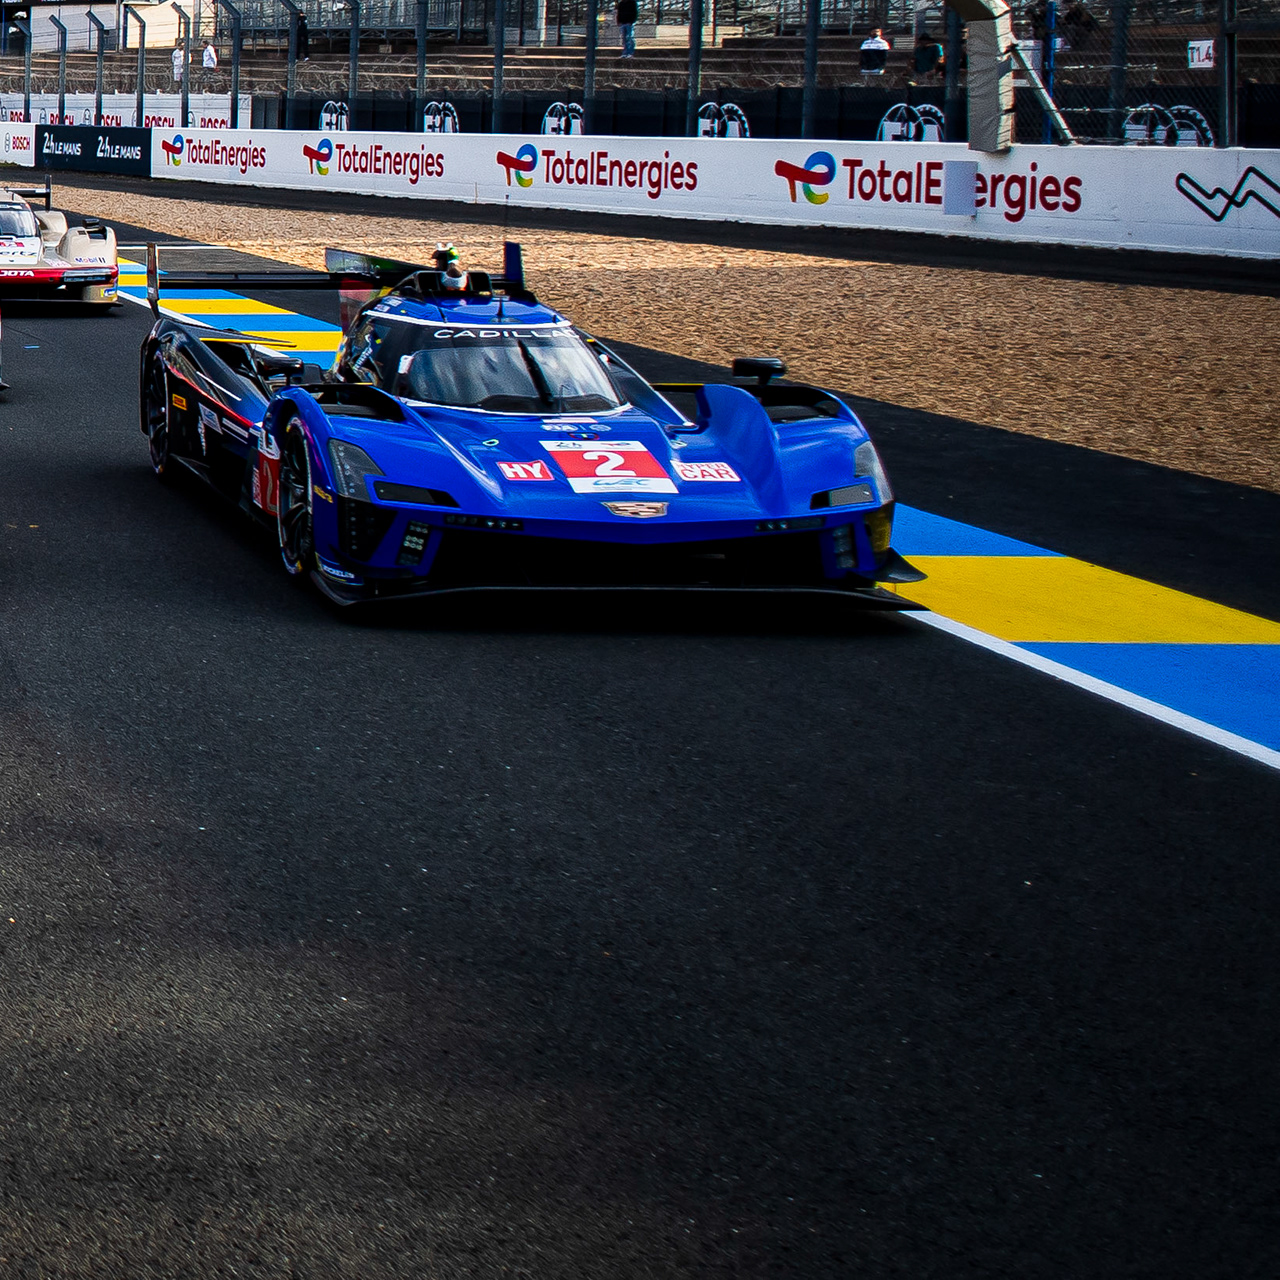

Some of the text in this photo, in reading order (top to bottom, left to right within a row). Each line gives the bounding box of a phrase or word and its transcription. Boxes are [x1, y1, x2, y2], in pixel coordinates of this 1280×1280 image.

[12, 136, 30, 150] BOSCH
[55, 142, 63, 154] LE
[63, 143, 82, 156] MANS
[110, 145, 120, 158] LE
[120, 146, 141, 160] MANS
[186, 138, 266, 170] TotalEnergies
[335, 143, 445, 185] TotalEnergies
[542, 149, 698, 200] TotalEnergies
[842, 158, 1083, 223] TotalEergies
[433, 329, 580, 339] CADILLAC
[505, 462, 542, 478] HY
[582, 452, 637, 476] 2
[681, 469, 733, 480] CAR
